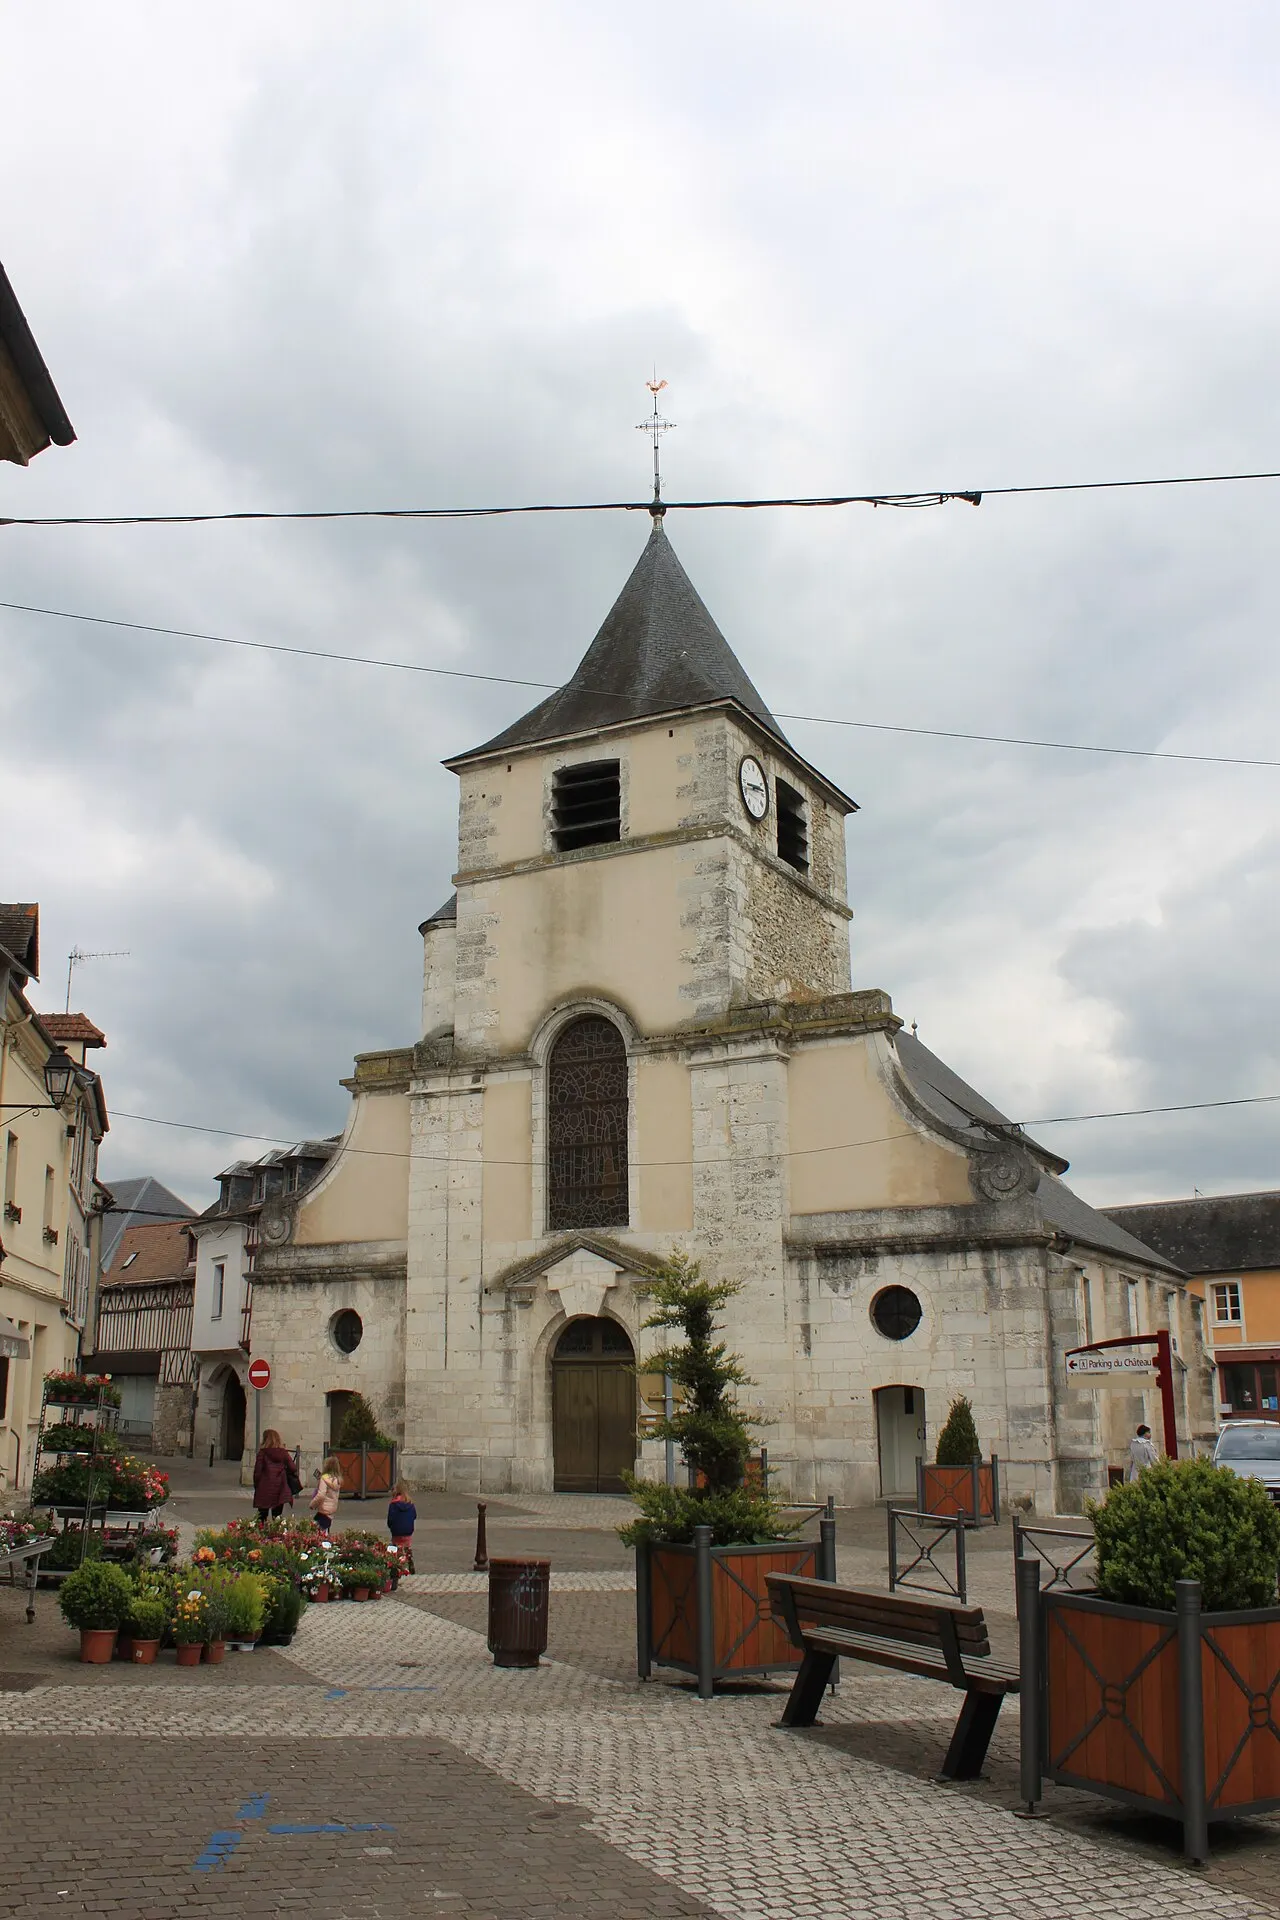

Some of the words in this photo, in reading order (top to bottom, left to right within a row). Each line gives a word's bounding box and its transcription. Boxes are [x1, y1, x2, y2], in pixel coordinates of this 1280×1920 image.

[1088, 1358, 1112, 1369] Parking
[1113, 1358, 1122, 1367] du
[1124, 1358, 1151, 1366] Château
